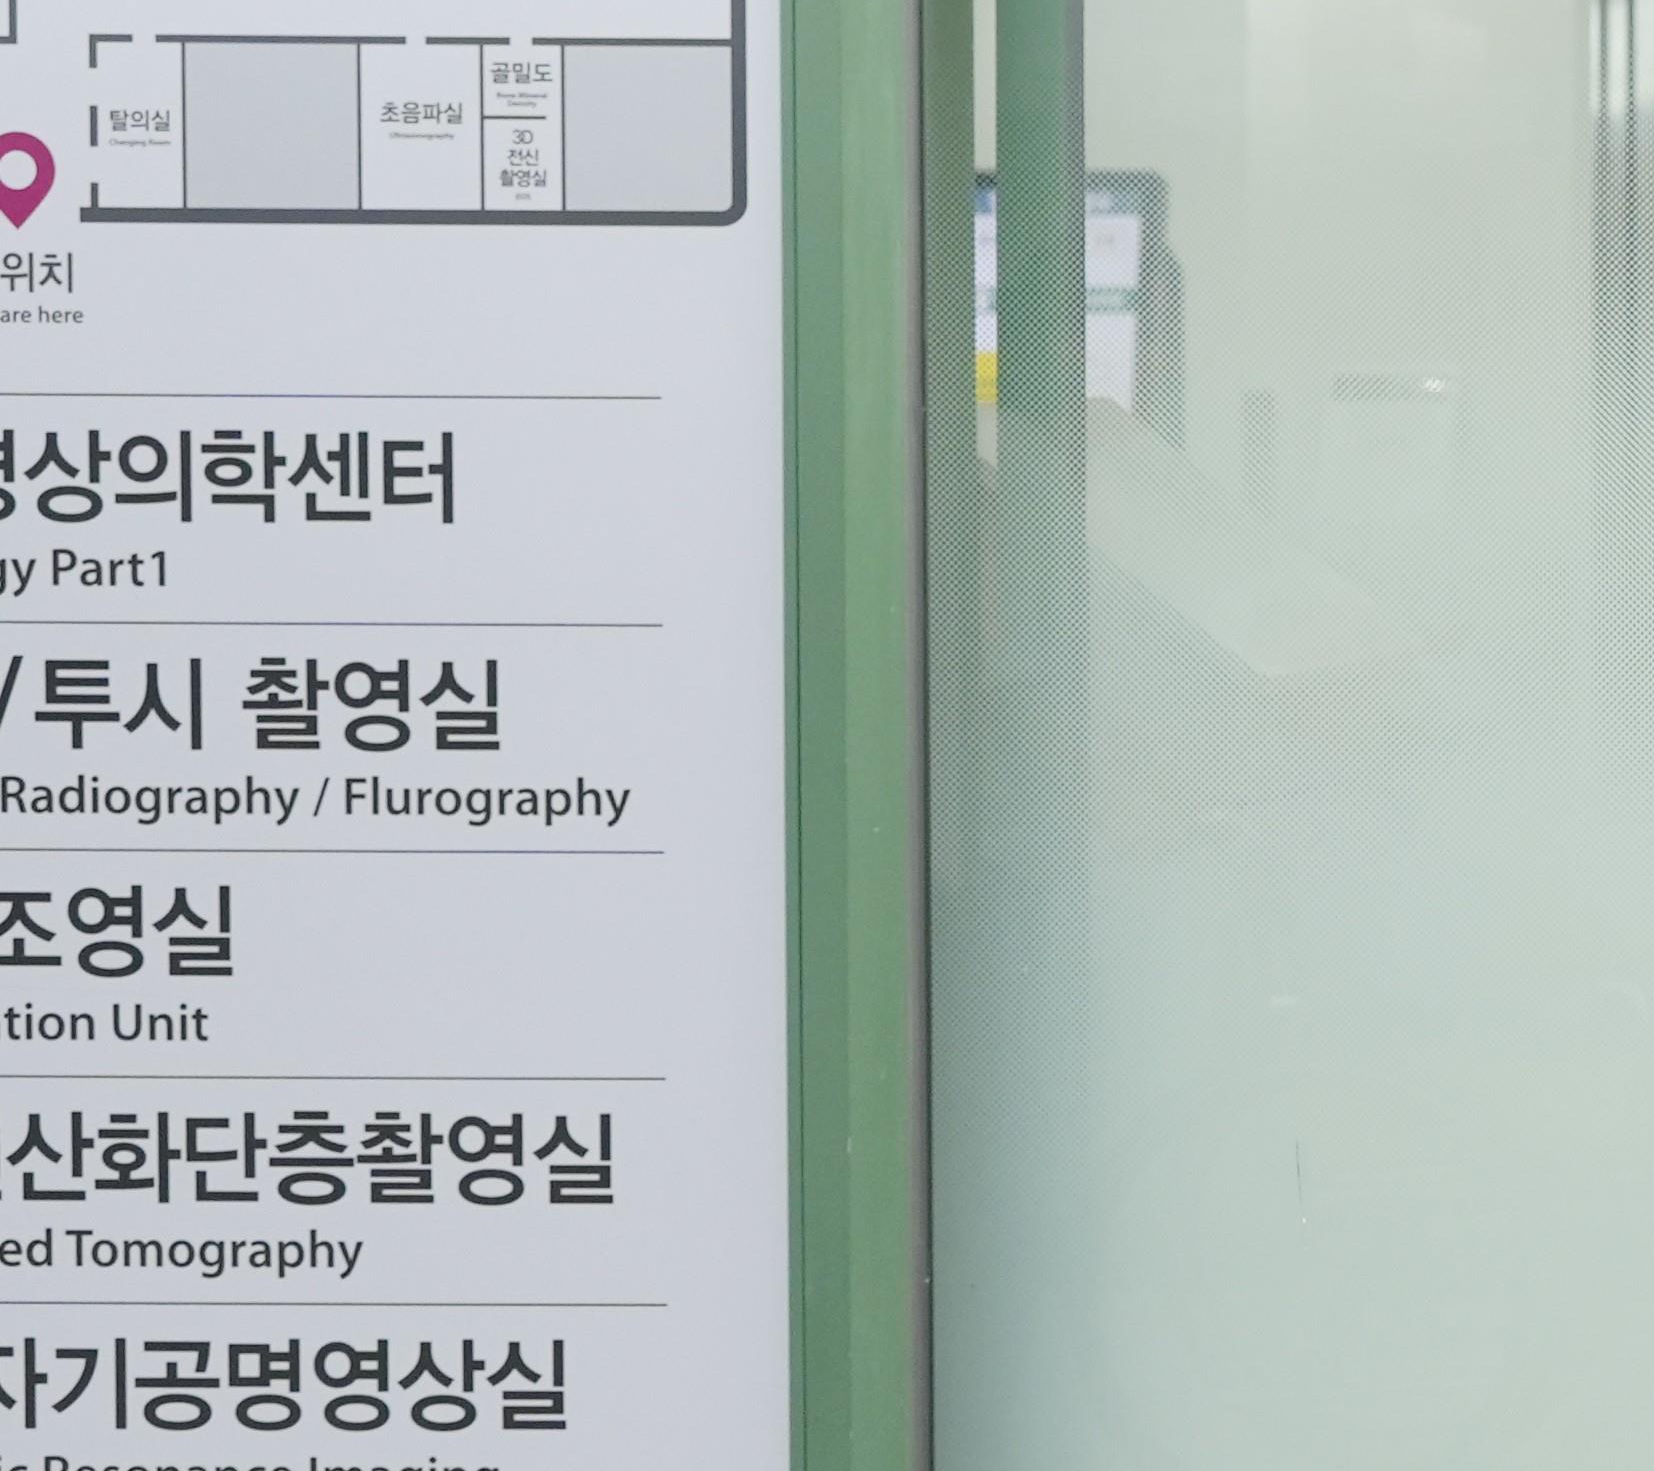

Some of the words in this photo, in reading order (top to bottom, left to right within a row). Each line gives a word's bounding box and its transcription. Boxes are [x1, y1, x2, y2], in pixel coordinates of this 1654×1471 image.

[491, 63, 552, 83] 골밀도
[110, 110, 169, 131] 탈의실
[381, 102, 462, 124] 초음파실
[508, 150, 538, 166] 전신
[500, 169, 546, 187] 촬영실
[0, 253, 72, 293] 위치
[0, 311, 31, 322] are
[39, 306, 83, 323] here
[53, 549, 165, 586] Part1
[243, 657, 500, 752] 촬영실
[1, 775, 299, 825] Radiography
[314, 777, 329, 816] /
[346, 776, 630, 827] Flurography
[0, 885, 232, 977] 조영실
[113, 1004, 208, 1041] Unit
[0, 1228, 52, 1266] ed
[66, 1230, 363, 1279] Tomography
[0, 1337, 566, 1431] 자기공명영상실
